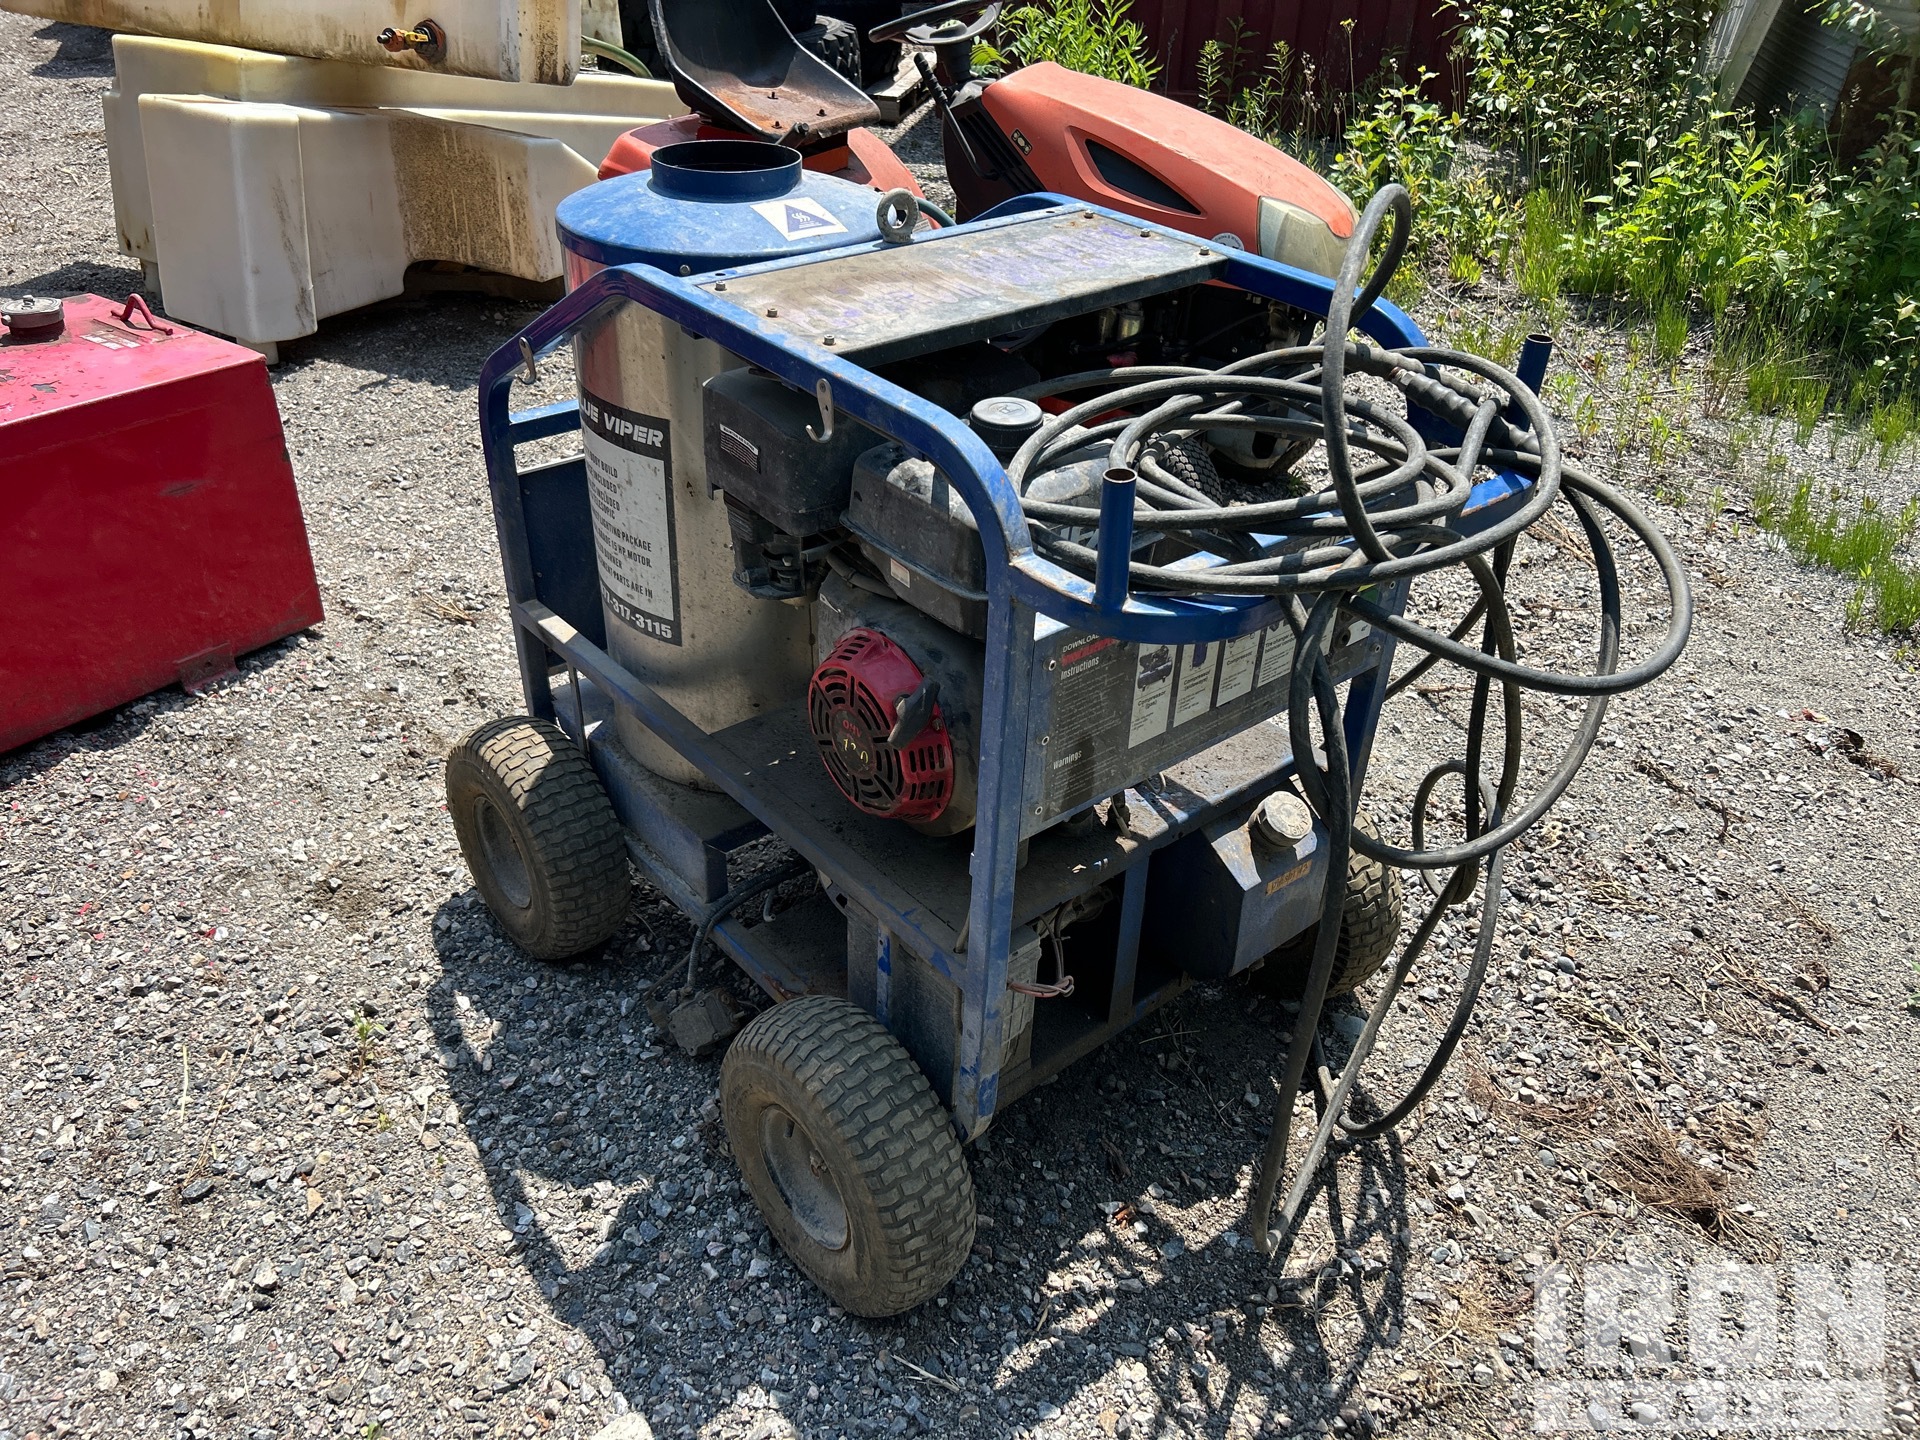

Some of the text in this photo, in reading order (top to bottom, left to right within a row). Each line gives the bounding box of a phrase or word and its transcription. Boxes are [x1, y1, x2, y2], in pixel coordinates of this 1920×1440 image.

[603, 411, 664, 448] VIPER
[601, 460, 618, 479] BUILD
[621, 531, 652, 553] PACKAGE
[613, 570, 653, 599] PARTS ARE IN
[1060, 656, 1100, 681] Instructions
[1053, 750, 1083, 770] Warnings
